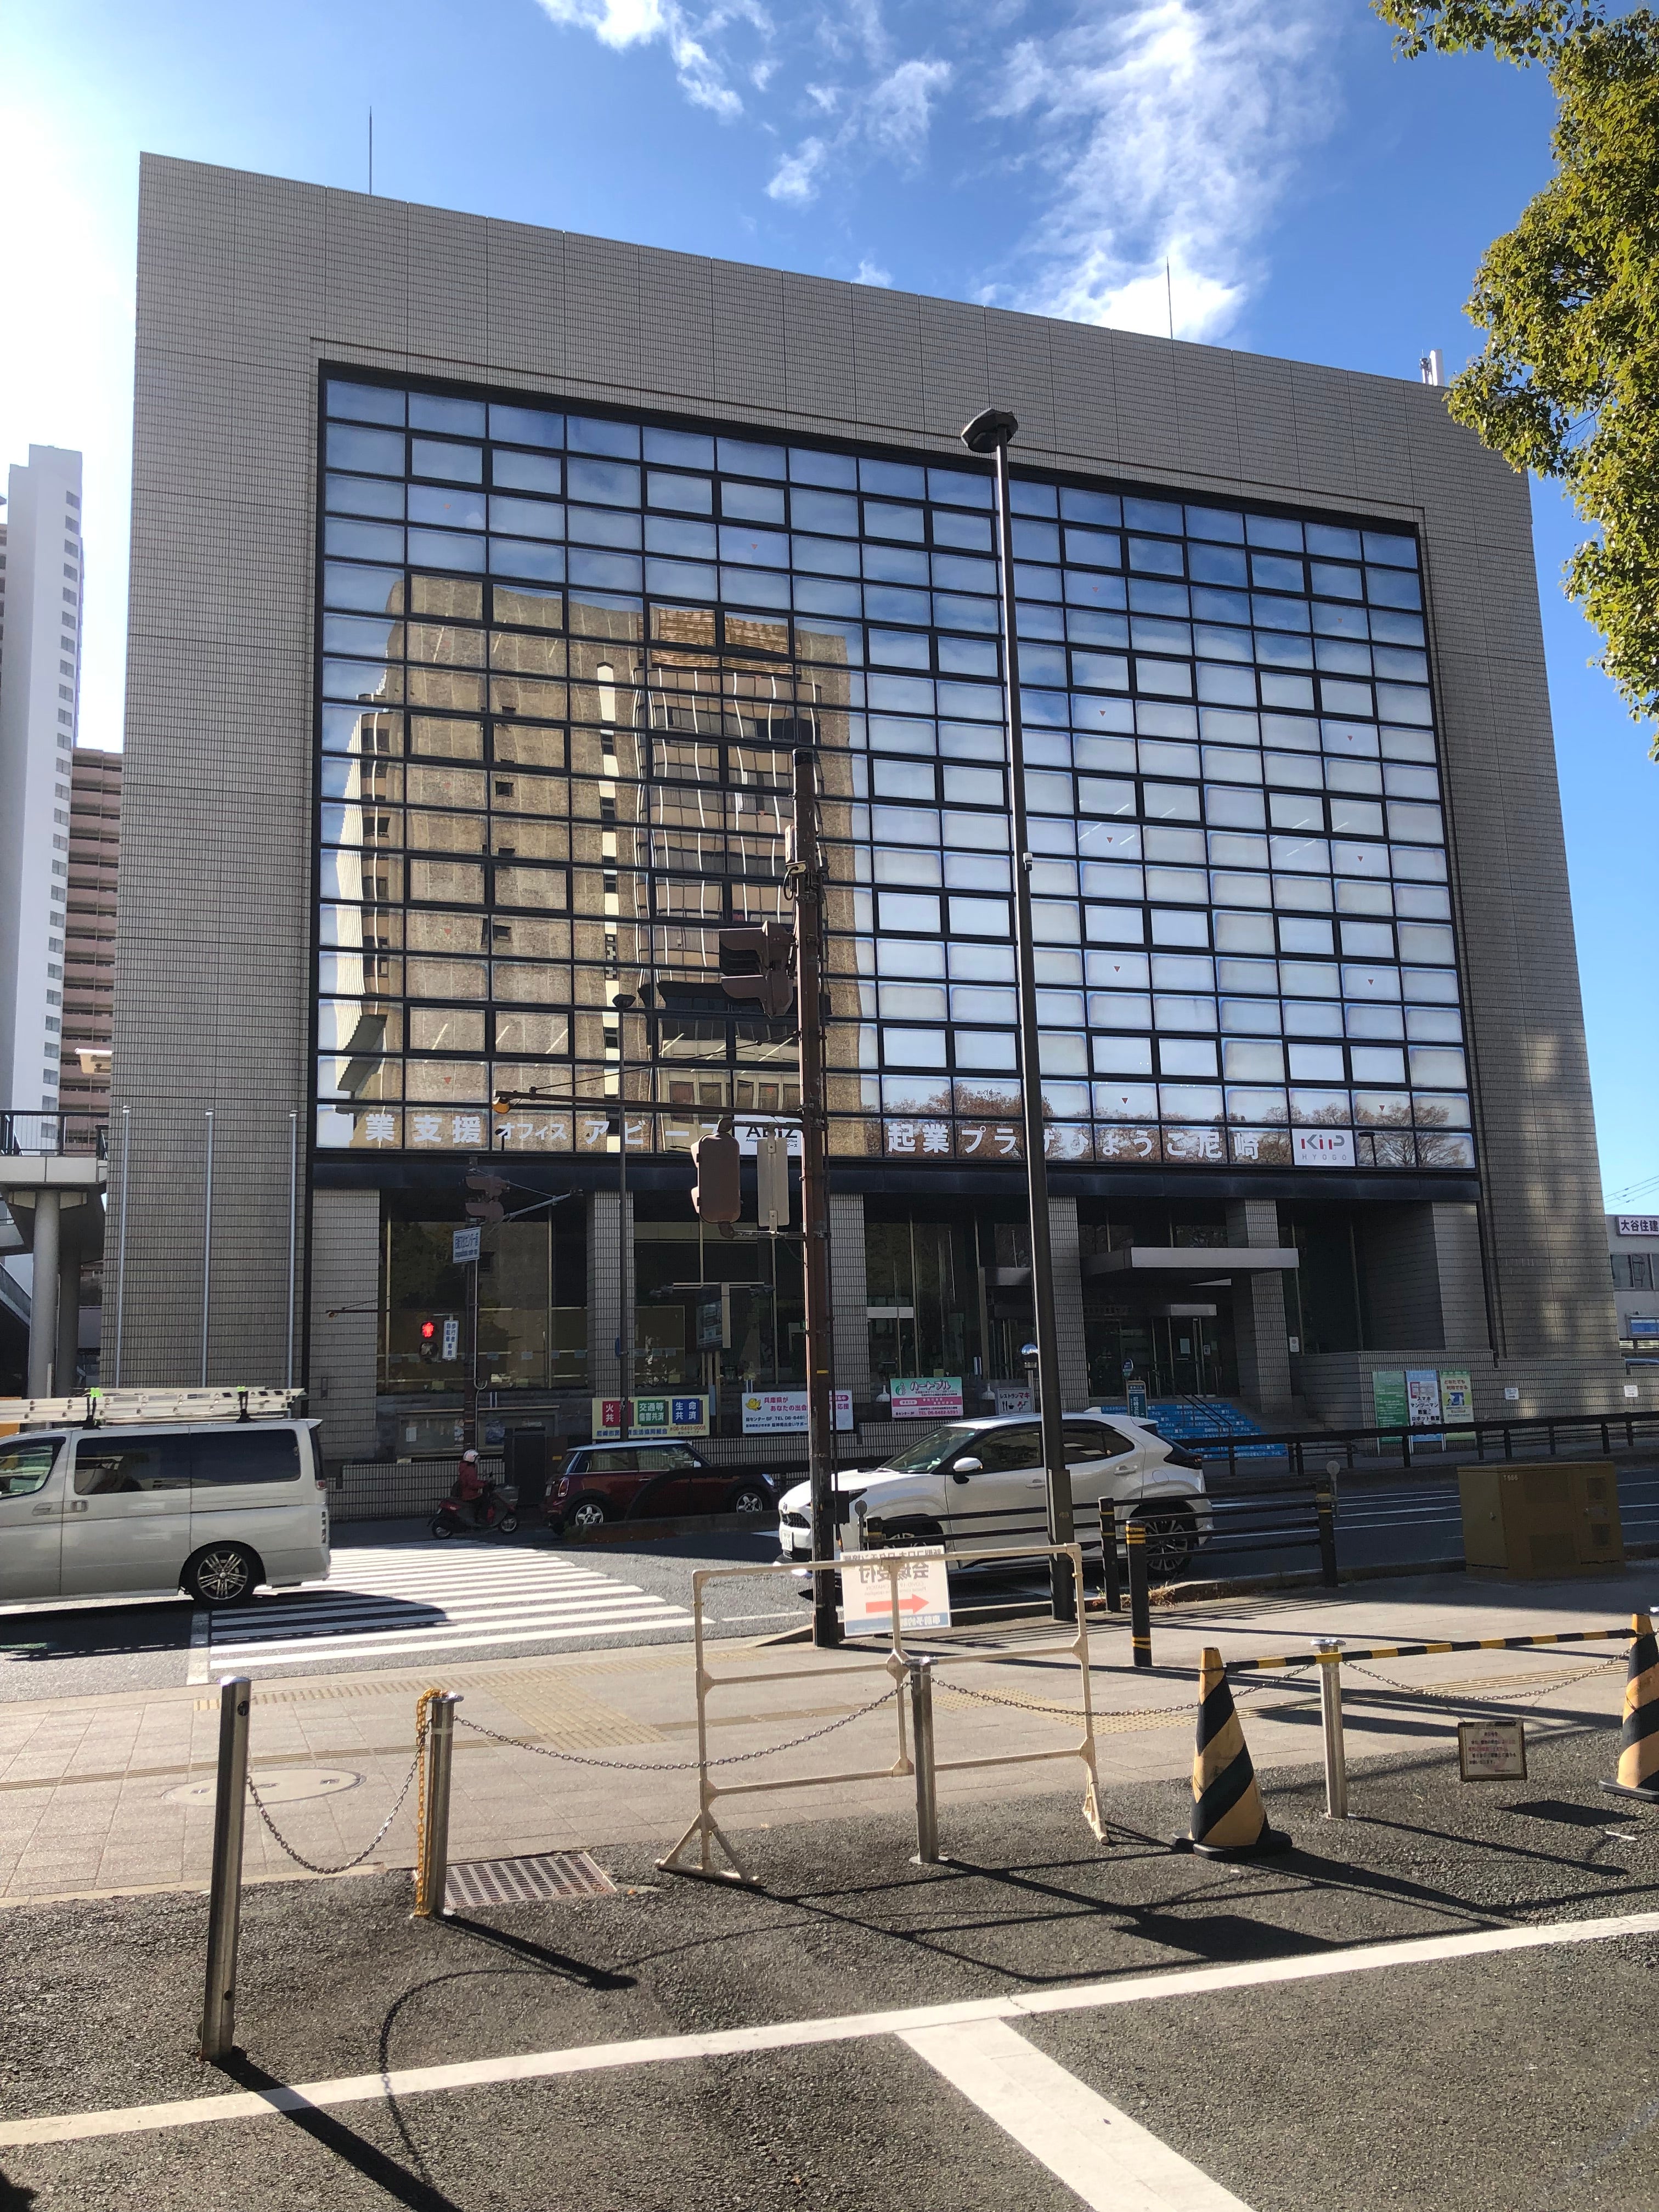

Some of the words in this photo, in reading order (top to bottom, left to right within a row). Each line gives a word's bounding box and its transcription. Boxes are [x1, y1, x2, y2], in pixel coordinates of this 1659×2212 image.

[1621, 1219, 1658, 1232] 大谷住建
[675, 1401, 697, 1411] 生命
[675, 1410, 697, 1420] 共済
[597, 1428, 668, 1437] 尼崎市民済生活協同組合
